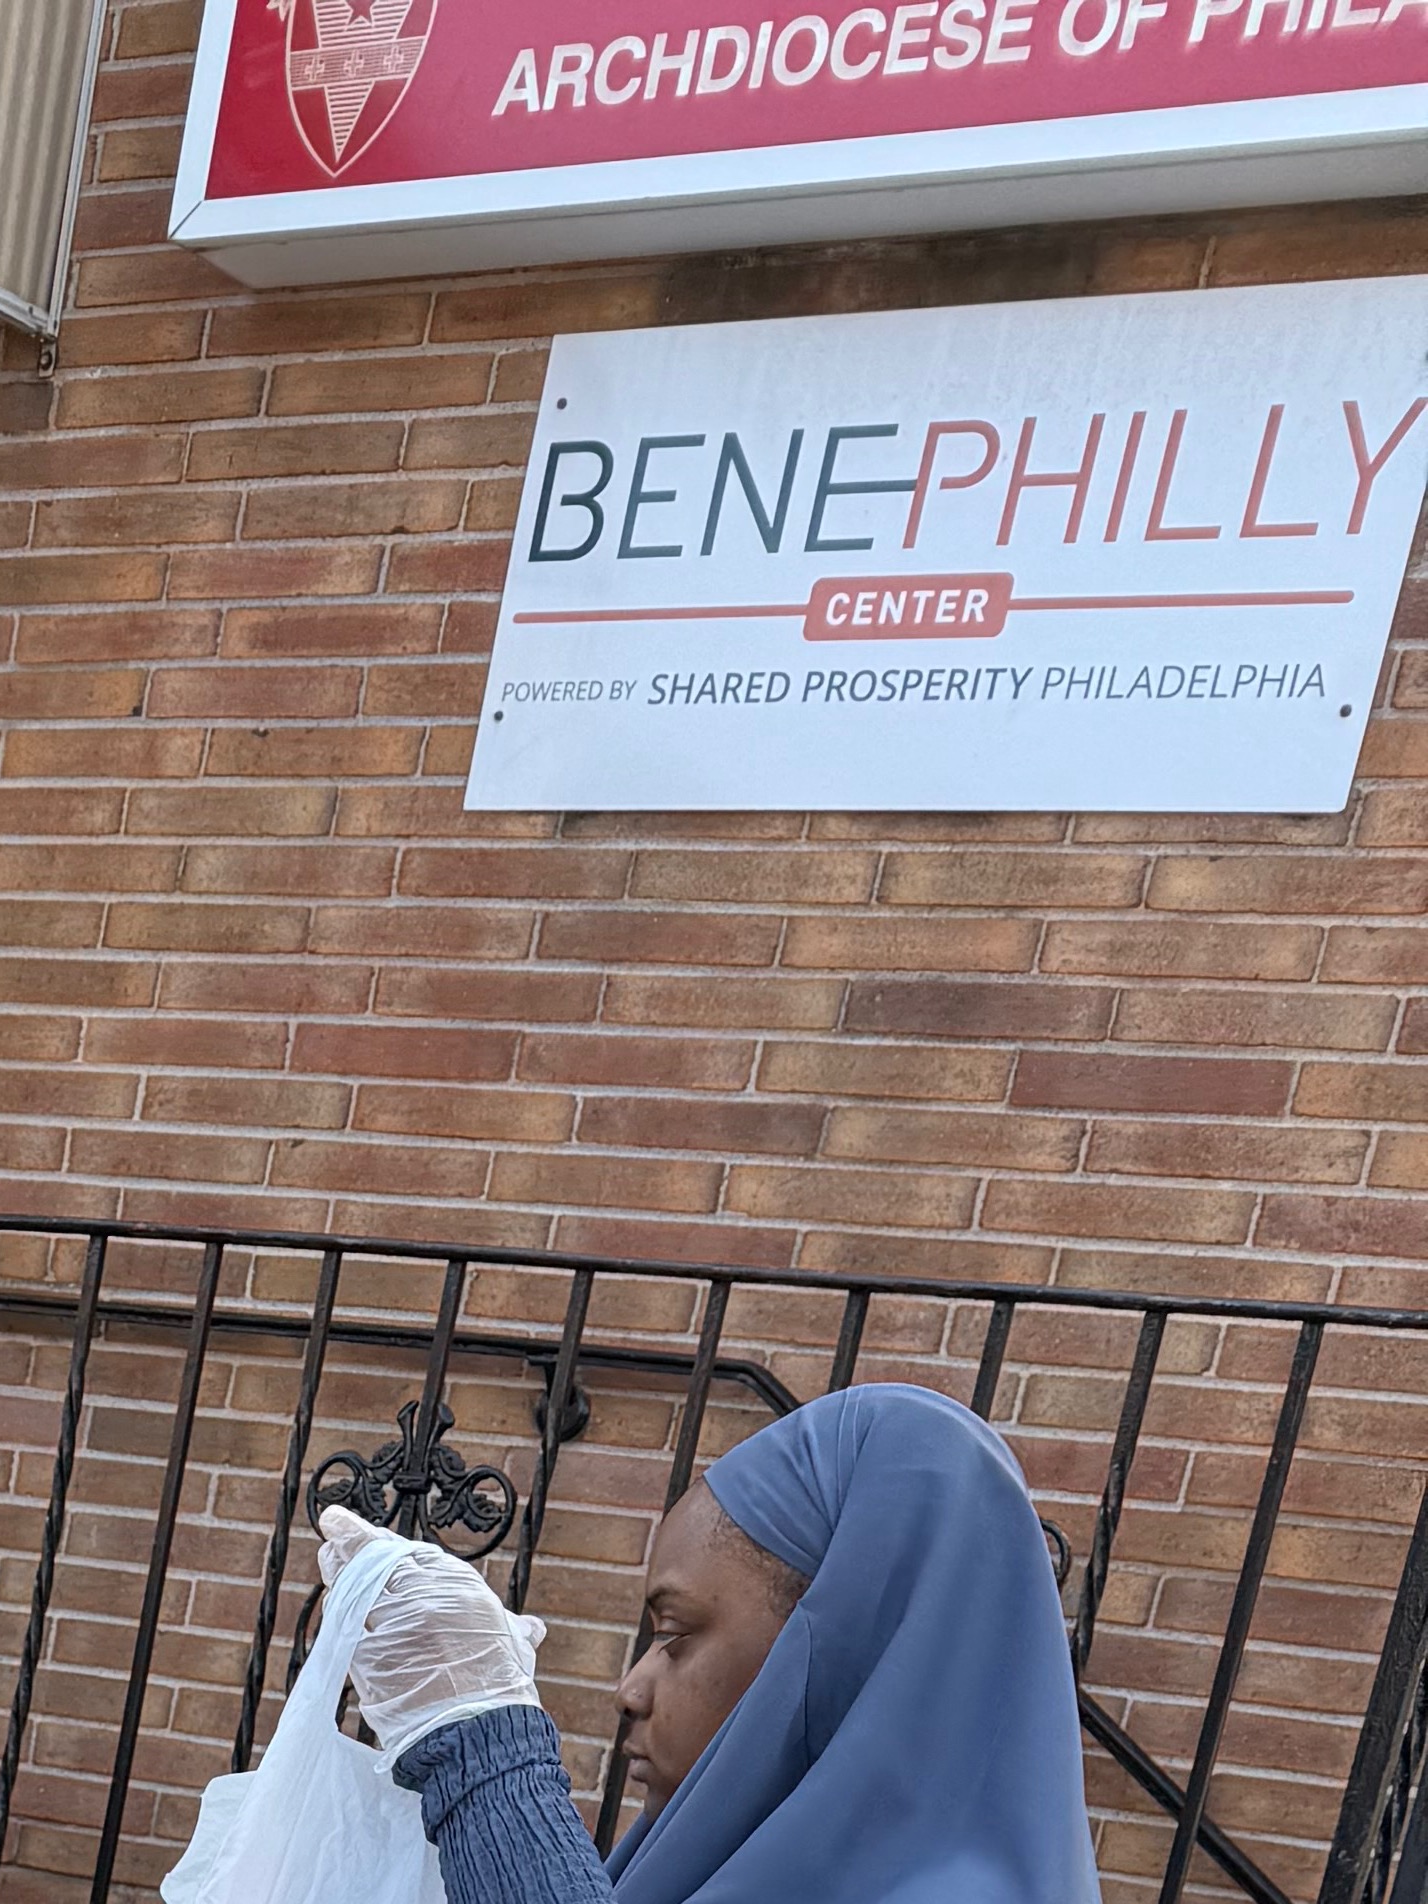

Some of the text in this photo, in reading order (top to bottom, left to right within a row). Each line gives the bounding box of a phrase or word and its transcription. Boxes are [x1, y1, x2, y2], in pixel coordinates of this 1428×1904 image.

[492, 0, 1165, 114] ARCHDIOCESE OF
[527, 396, 1428, 563] BENEPHILLY
[824, 590, 990, 628] CENTER
[500, 662, 1326, 706] POWERED BY SHARED PROSPERITY PHILADELPHIA
